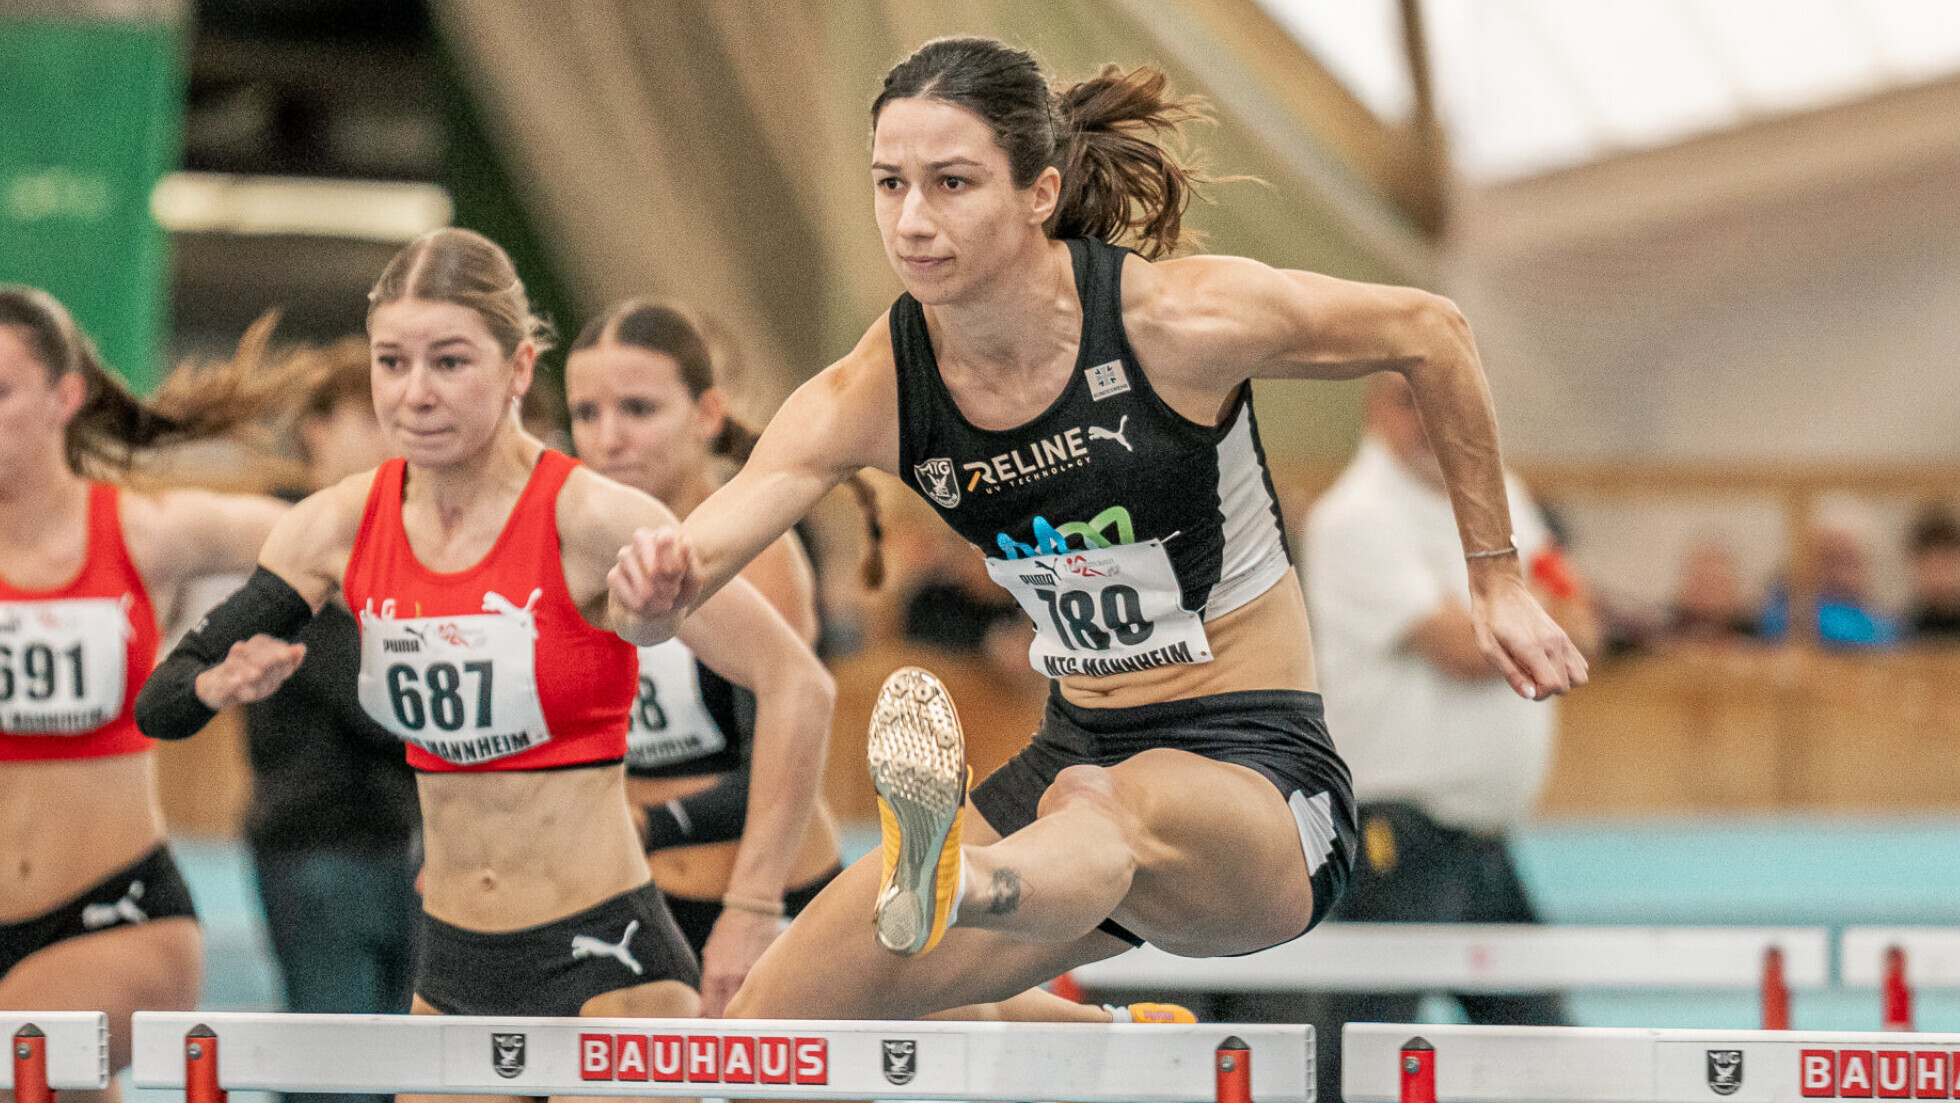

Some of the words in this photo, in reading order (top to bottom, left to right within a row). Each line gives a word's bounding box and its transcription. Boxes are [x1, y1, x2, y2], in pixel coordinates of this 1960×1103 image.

[963, 427, 1088, 492] RELINE
[1009, 456, 1091, 487] TECHNOLOGY
[1082, 631, 1194, 677] MANNHEIM
[387, 660, 493, 731] 687
[583, 1040, 824, 1076] BAUHAUS
[1804, 1056, 1960, 1092] BAUH
